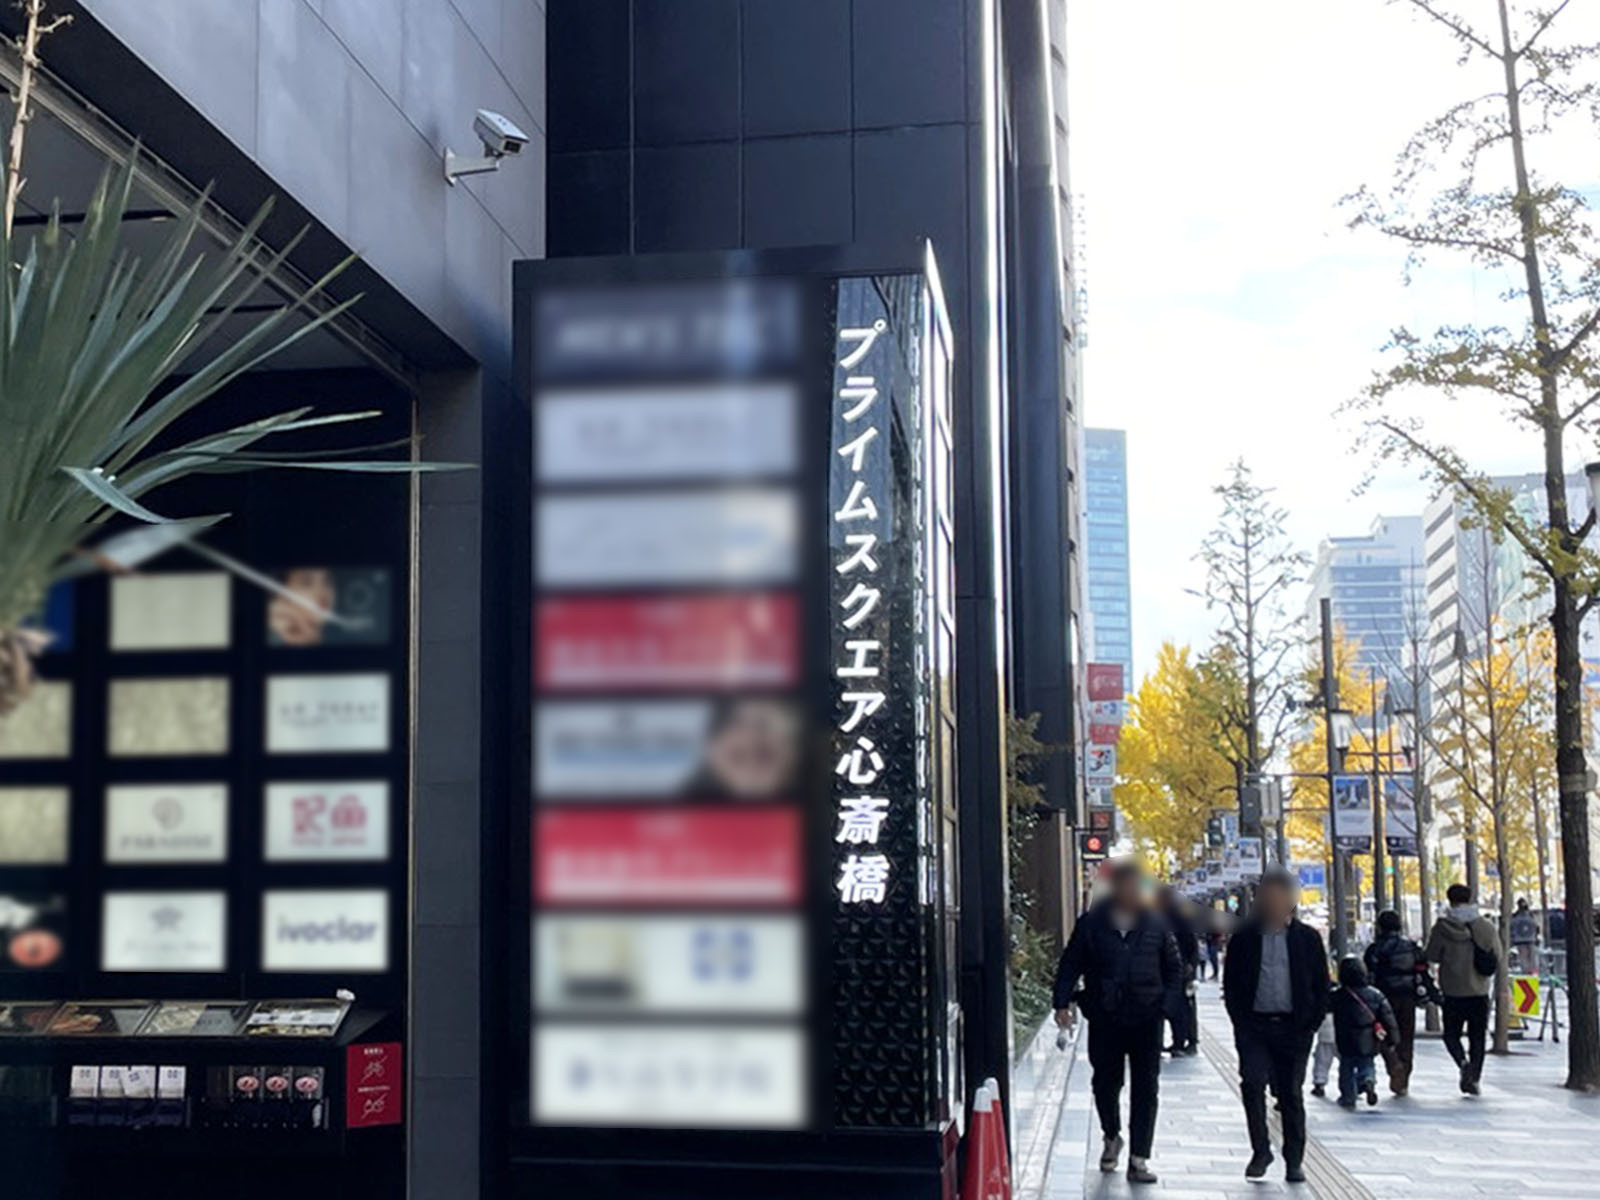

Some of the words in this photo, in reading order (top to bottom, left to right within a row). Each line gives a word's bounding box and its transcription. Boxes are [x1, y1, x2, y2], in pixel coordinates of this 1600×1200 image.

[835, 319, 890, 904] プライムスクエア心斎橋
[276, 915, 378, 943] ivoclar
